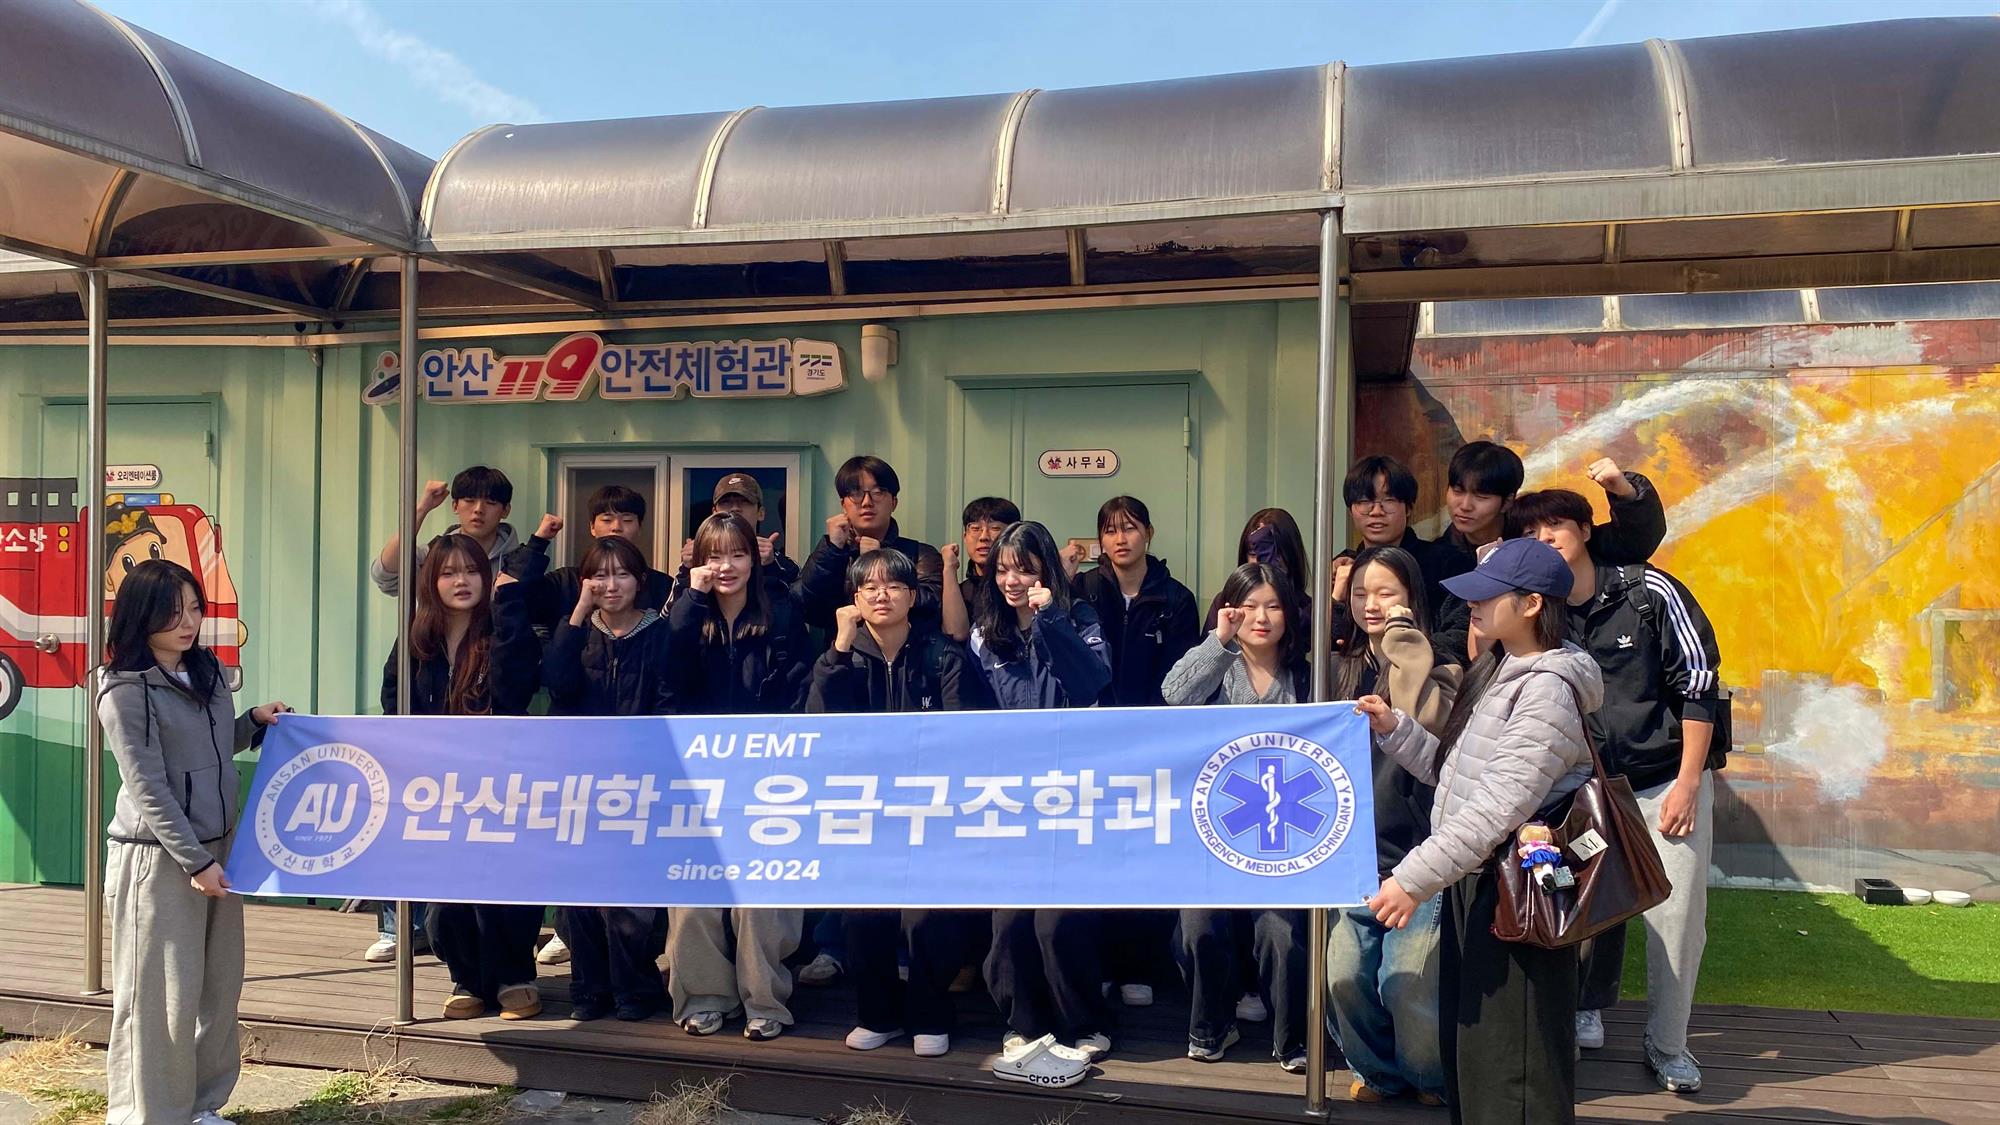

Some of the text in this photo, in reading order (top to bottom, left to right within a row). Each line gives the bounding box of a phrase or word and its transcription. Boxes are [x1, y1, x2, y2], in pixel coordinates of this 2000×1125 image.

[424, 337, 791, 396] 안산 119 안전체험관
[807, 369, 825, 377] 경기도
[117, 470, 157, 481] 오리엔테이션룸
[1066, 456, 1105, 469] 사무실
[0, 526, 48, 552] 소방
[684, 732, 821, 759] AU EMT
[266, 746, 385, 807] ANSAN UNIVERSITY
[1196, 734, 1352, 796] ANSAN UNIVERSITY
[284, 783, 359, 832] AU
[402, 768, 1181, 846] 안산대학교 응급구조학과
[1194, 804, 1352, 874] EMERGENCY MEDICAL TECHNICIAN
[267, 842, 356, 872] 안산대학교
[666, 858, 821, 881] since 2024
[1028, 1074, 1066, 1084] crocs
